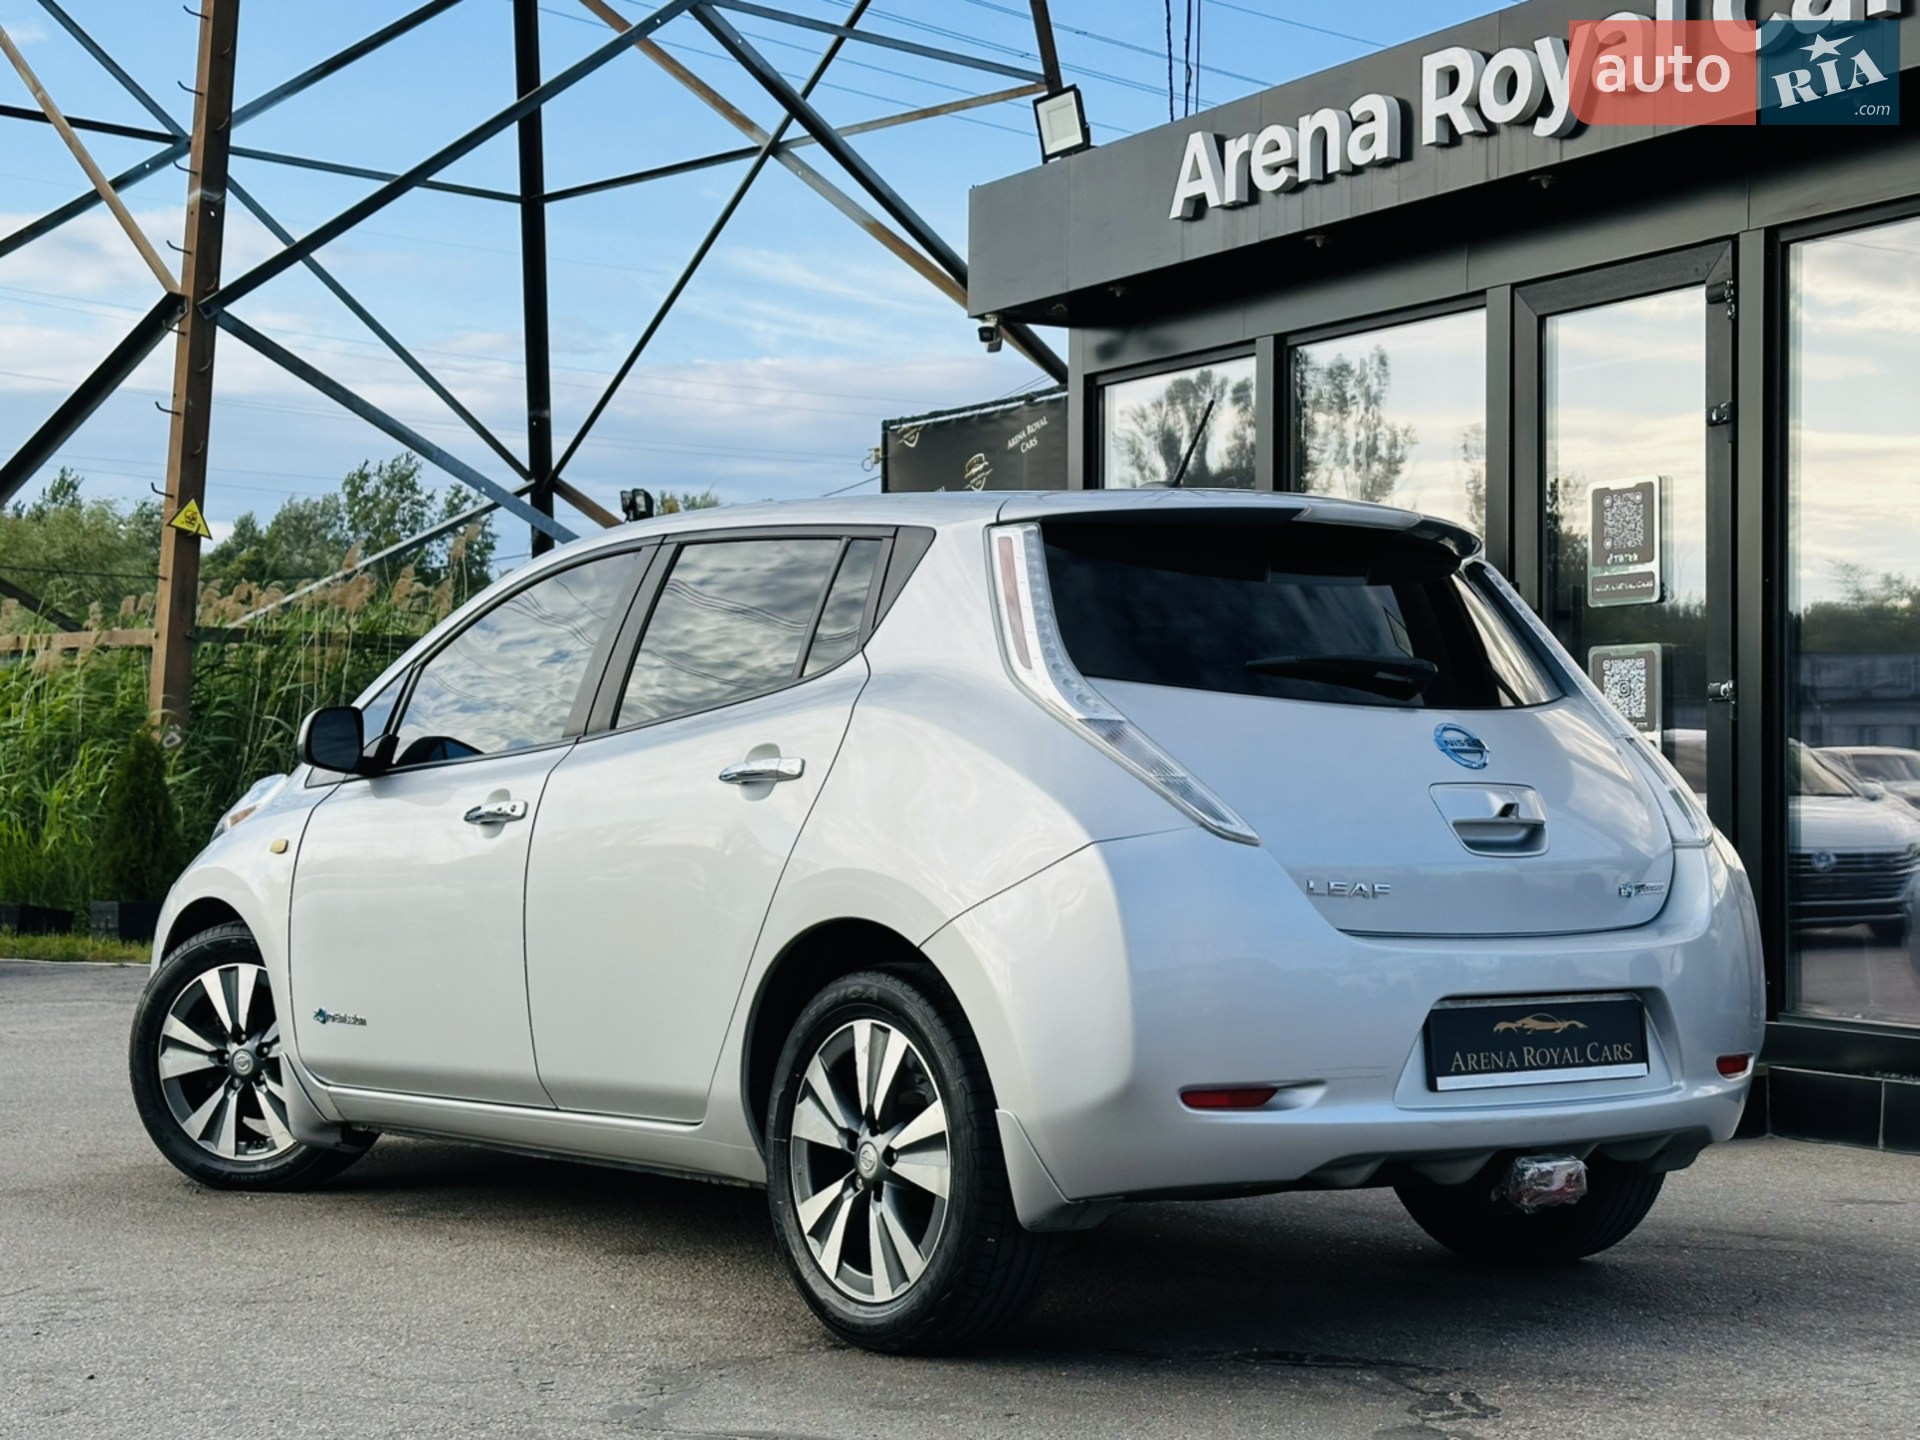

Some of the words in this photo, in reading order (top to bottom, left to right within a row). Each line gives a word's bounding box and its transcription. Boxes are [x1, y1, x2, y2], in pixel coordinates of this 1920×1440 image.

[1169, 93, 1400, 221] Arena
[1421, 0, 1687, 146] Royal
[1305, 879, 1392, 899] LEAF
[1450, 1050, 1519, 1073] ARENA
[1522, 1045, 1585, 1068] ROYAL
[1586, 1042, 1634, 1062] CARS
